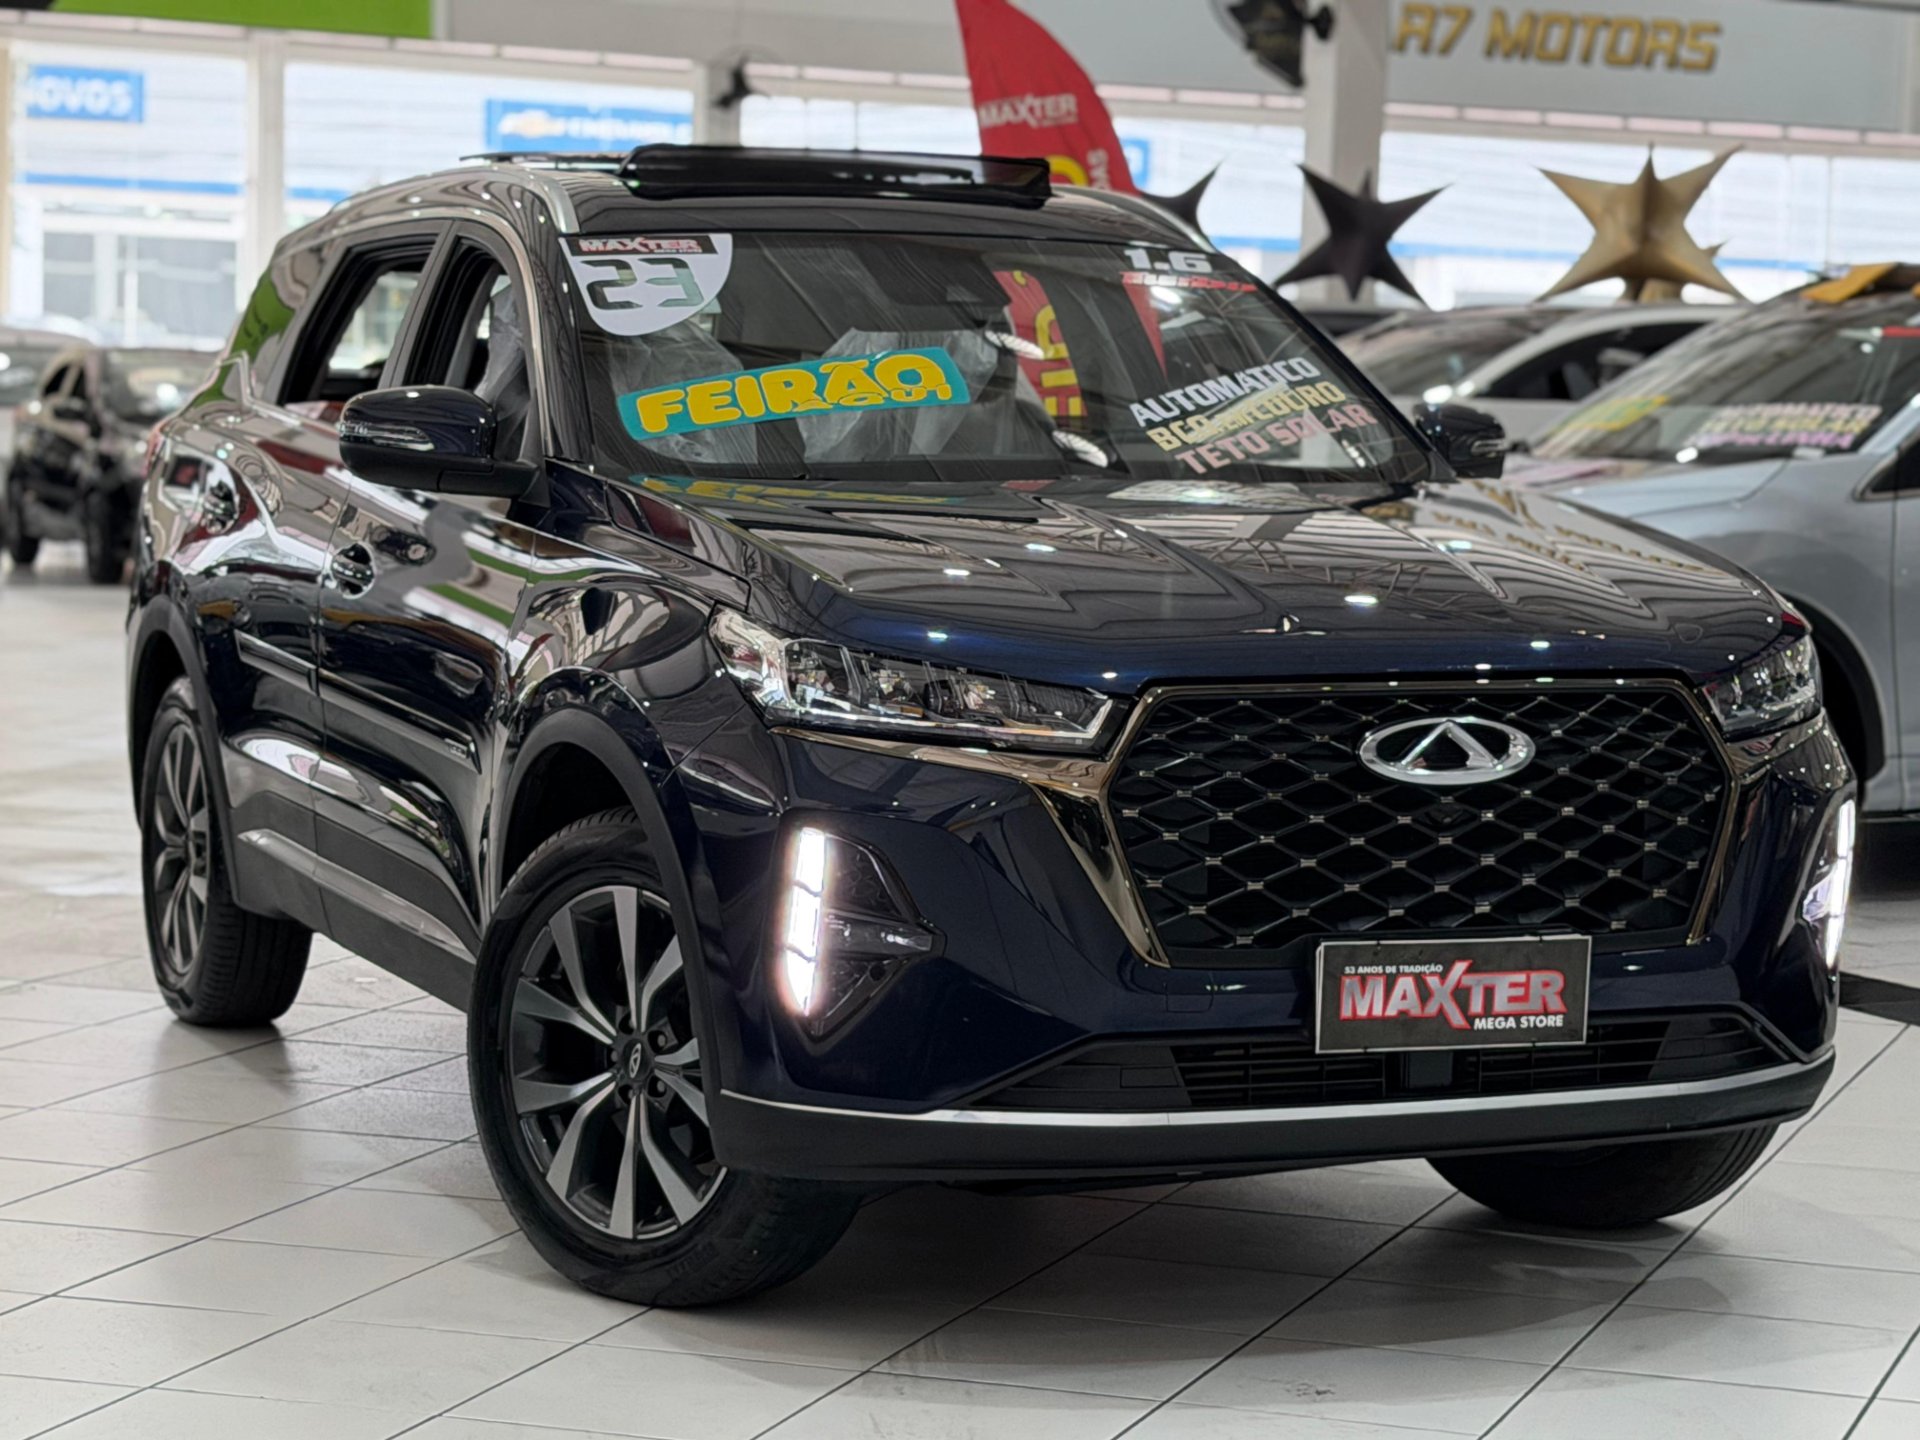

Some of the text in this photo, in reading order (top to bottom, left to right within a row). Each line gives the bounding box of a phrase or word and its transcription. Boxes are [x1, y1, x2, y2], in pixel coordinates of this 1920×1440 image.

[1394, 3, 1721, 72] R7 MOTORS
[978, 92, 1077, 129] MAXTER
[579, 237, 699, 253] MAXTER
[1124, 248, 1212, 273] 1.6
[580, 257, 705, 311] 23
[636, 353, 949, 433] FEIRÃO
[1174, 403, 1378, 475] TETO SOLAR
[1357, 964, 1383, 974] ANOS
[1385, 964, 1397, 974] DE
[1399, 962, 1443, 975] TRADIÇÃO
[1339, 959, 1567, 1030] MAXTER
[1474, 1014, 1563, 1030] MEGA STORE
